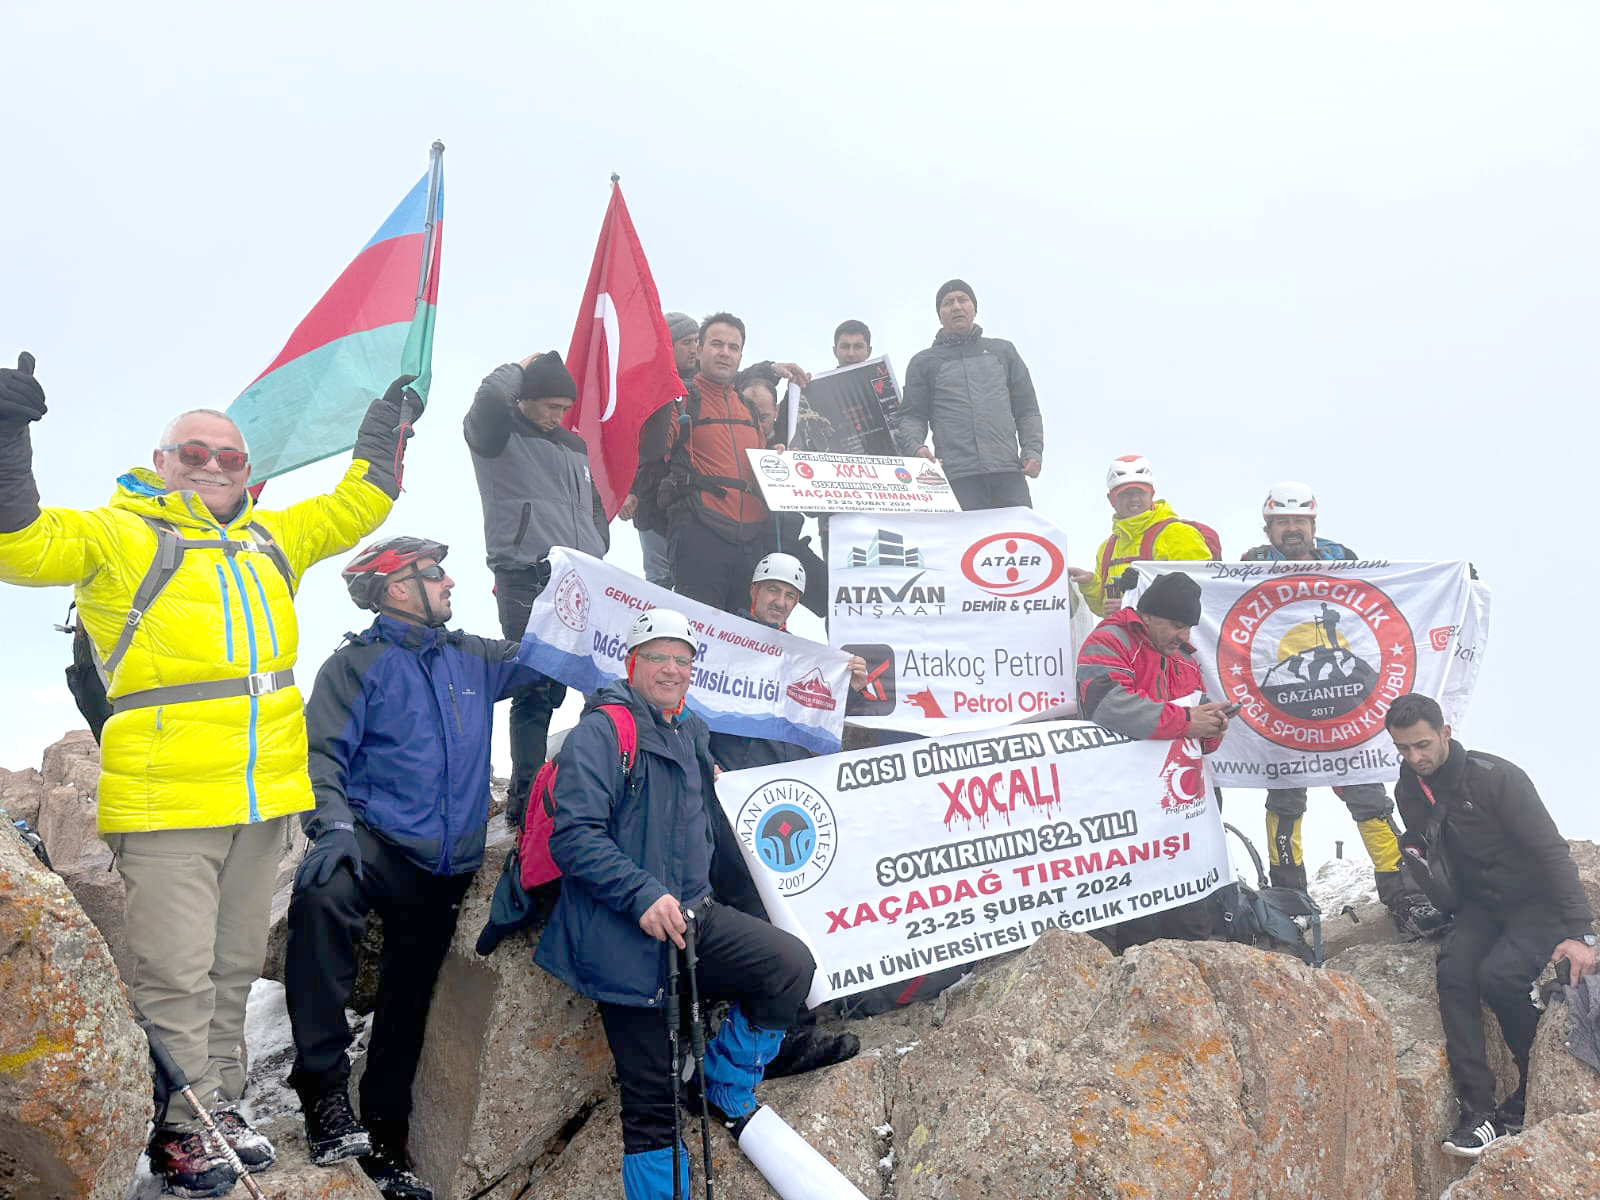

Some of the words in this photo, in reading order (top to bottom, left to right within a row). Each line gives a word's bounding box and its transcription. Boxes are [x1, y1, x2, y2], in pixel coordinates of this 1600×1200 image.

[832, 463, 879, 479] XOCALI
[888, 483, 909, 491] YILI
[792, 489, 862, 499] HAÇADAĞ
[865, 491, 934, 502] TIRMANIŞI
[980, 556, 1042, 567] ATAER
[1268, 561, 1323, 574] korur
[835, 571, 945, 604] ATAVAN
[961, 597, 1006, 612] DEMİR
[1009, 600, 1021, 612] &
[1023, 595, 1066, 615] ÇELİK
[1231, 591, 1274, 645] GAZİ
[717, 629, 783, 657] MÜDÜRLÜĞÜ
[902, 648, 985, 685] Atakoç
[994, 647, 1064, 677] Petrol
[690, 666, 780, 703] EMSİLCİLİĞİ
[953, 690, 1013, 713] Petrol
[1232, 683, 1270, 727] DOĞA
[1311, 706, 1336, 717] 2017
[836, 753, 907, 792] ACISI
[913, 732, 1045, 777] DİNMEYEN
[1048, 726, 1133, 754] KATL
[937, 763, 1061, 828] XOCALI
[763, 784, 832, 871] ÜNİVERSİTESİ
[876, 828, 1037, 887] SOYKIRIMIN
[1038, 821, 1082, 851] 32.
[1080, 809, 1138, 843] YILI
[778, 872, 805, 890] 2007
[825, 868, 1002, 934] XAÇADAĞ
[1012, 832, 1191, 887] TIRMANIŞI
[905, 907, 976, 940] 23-25
[983, 887, 1067, 923] ŞUBAT
[1076, 872, 1132, 899] 2024
[827, 963, 874, 991] MAN
[880, 921, 1027, 976] ÜNİVERSİTESİ
[1031, 900, 1122, 937] DAĞCILIK
